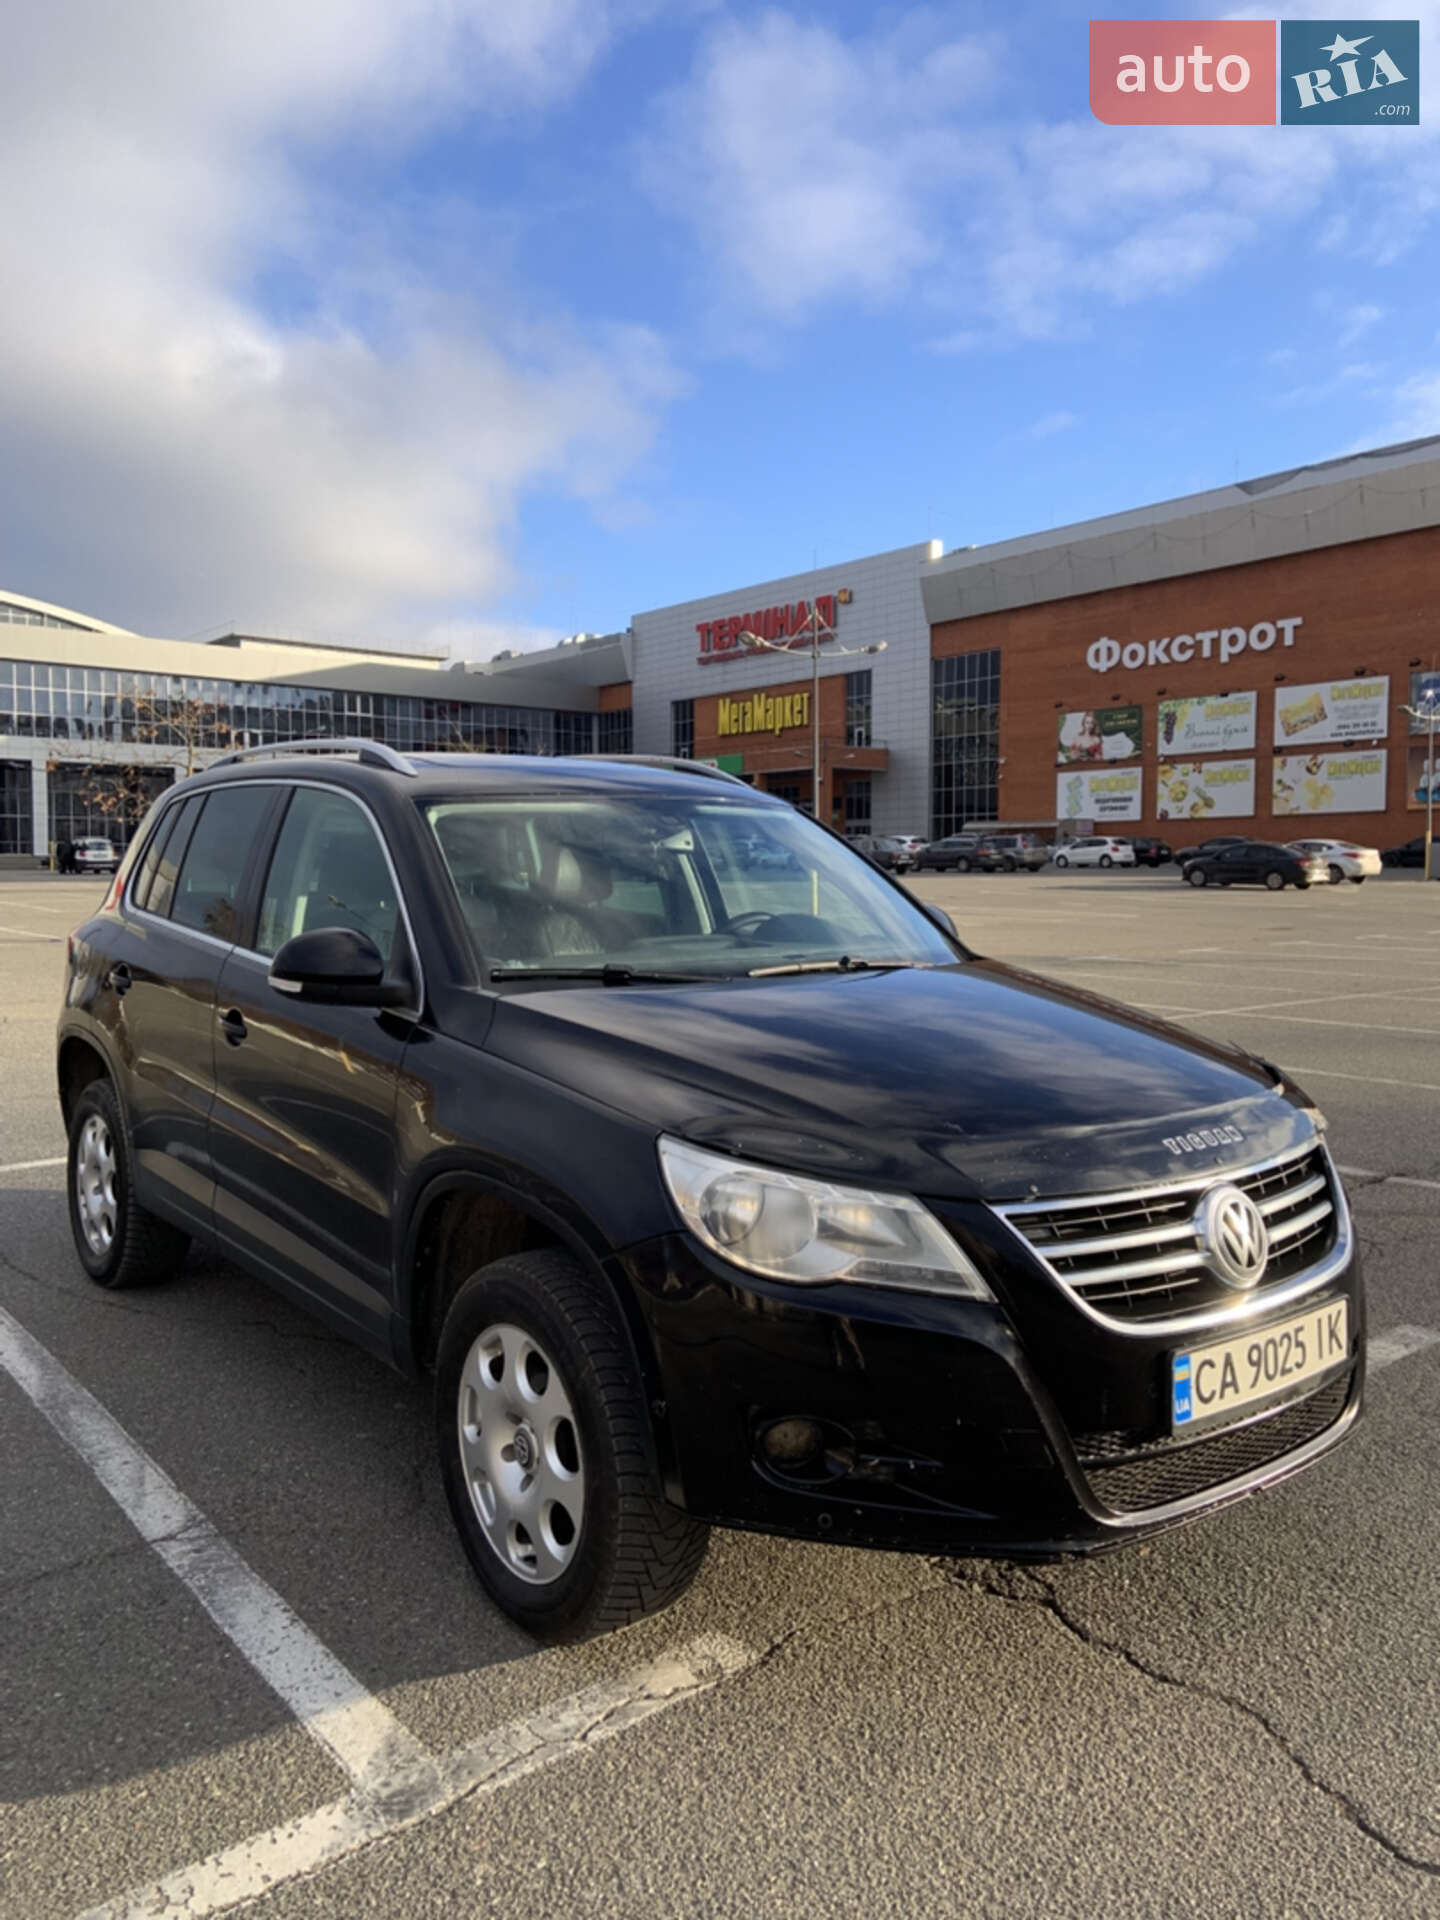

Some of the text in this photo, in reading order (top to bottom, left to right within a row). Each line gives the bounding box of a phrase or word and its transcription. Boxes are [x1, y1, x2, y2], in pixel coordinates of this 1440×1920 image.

[696, 594, 835, 652] ТЕРМІНАЛ
[1086, 617, 1304, 673] Фокстрот
[717, 692, 809, 736] МегаМаркет
[1195, 1309, 1344, 1405] CA 9025 IK
[1176, 1397, 1191, 1415] UA
